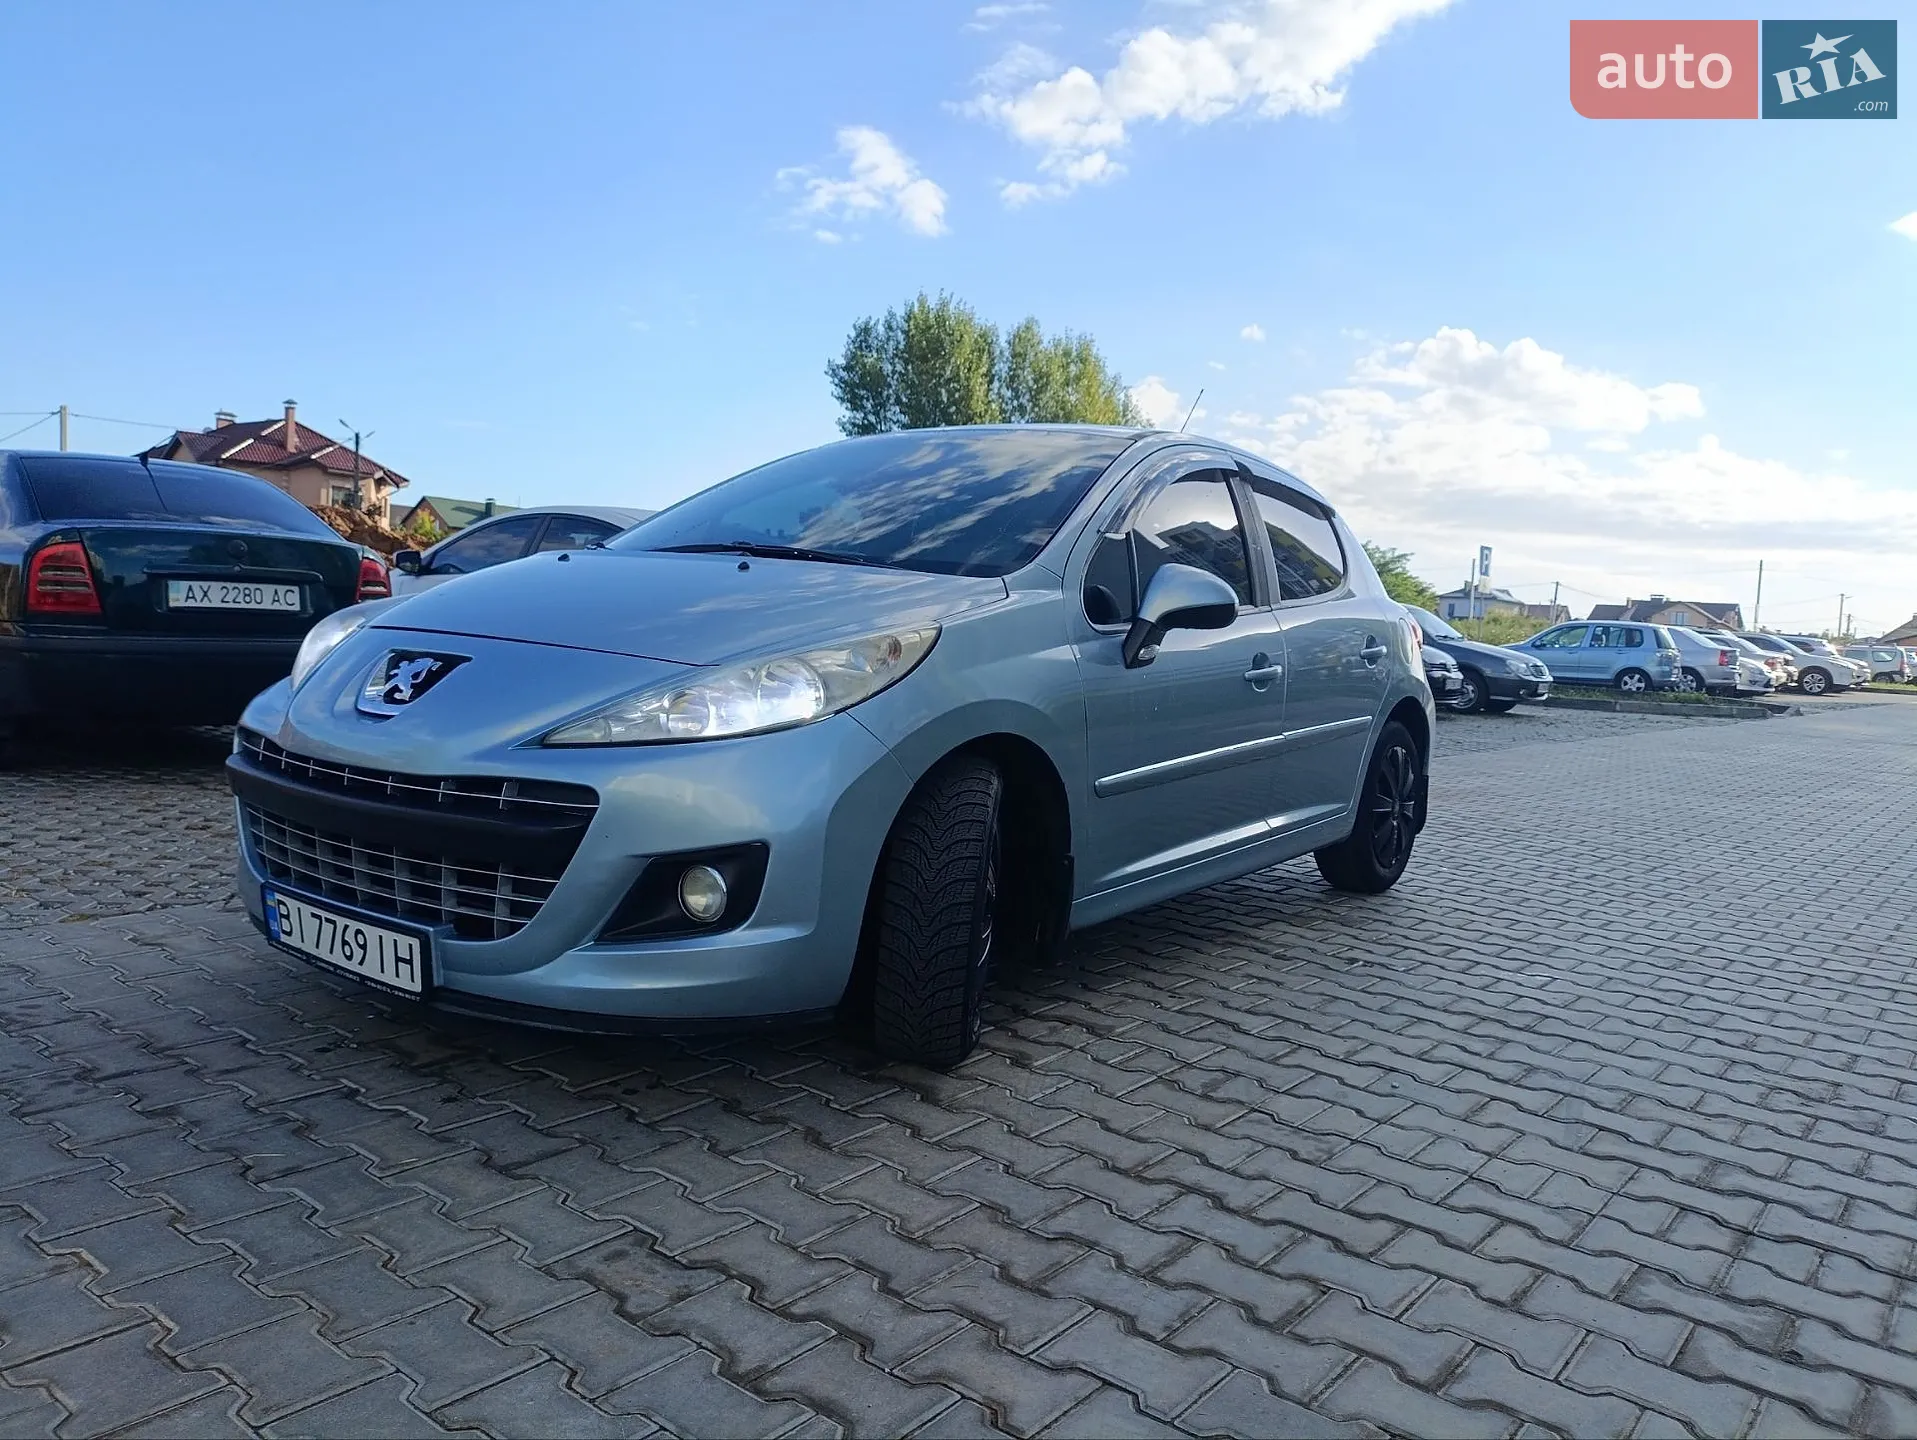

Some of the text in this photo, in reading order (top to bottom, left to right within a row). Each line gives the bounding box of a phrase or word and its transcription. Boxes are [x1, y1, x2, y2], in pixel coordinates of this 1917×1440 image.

[184, 584, 296, 607] AX 2280 AC
[276, 898, 416, 984] BI 7769 IH
